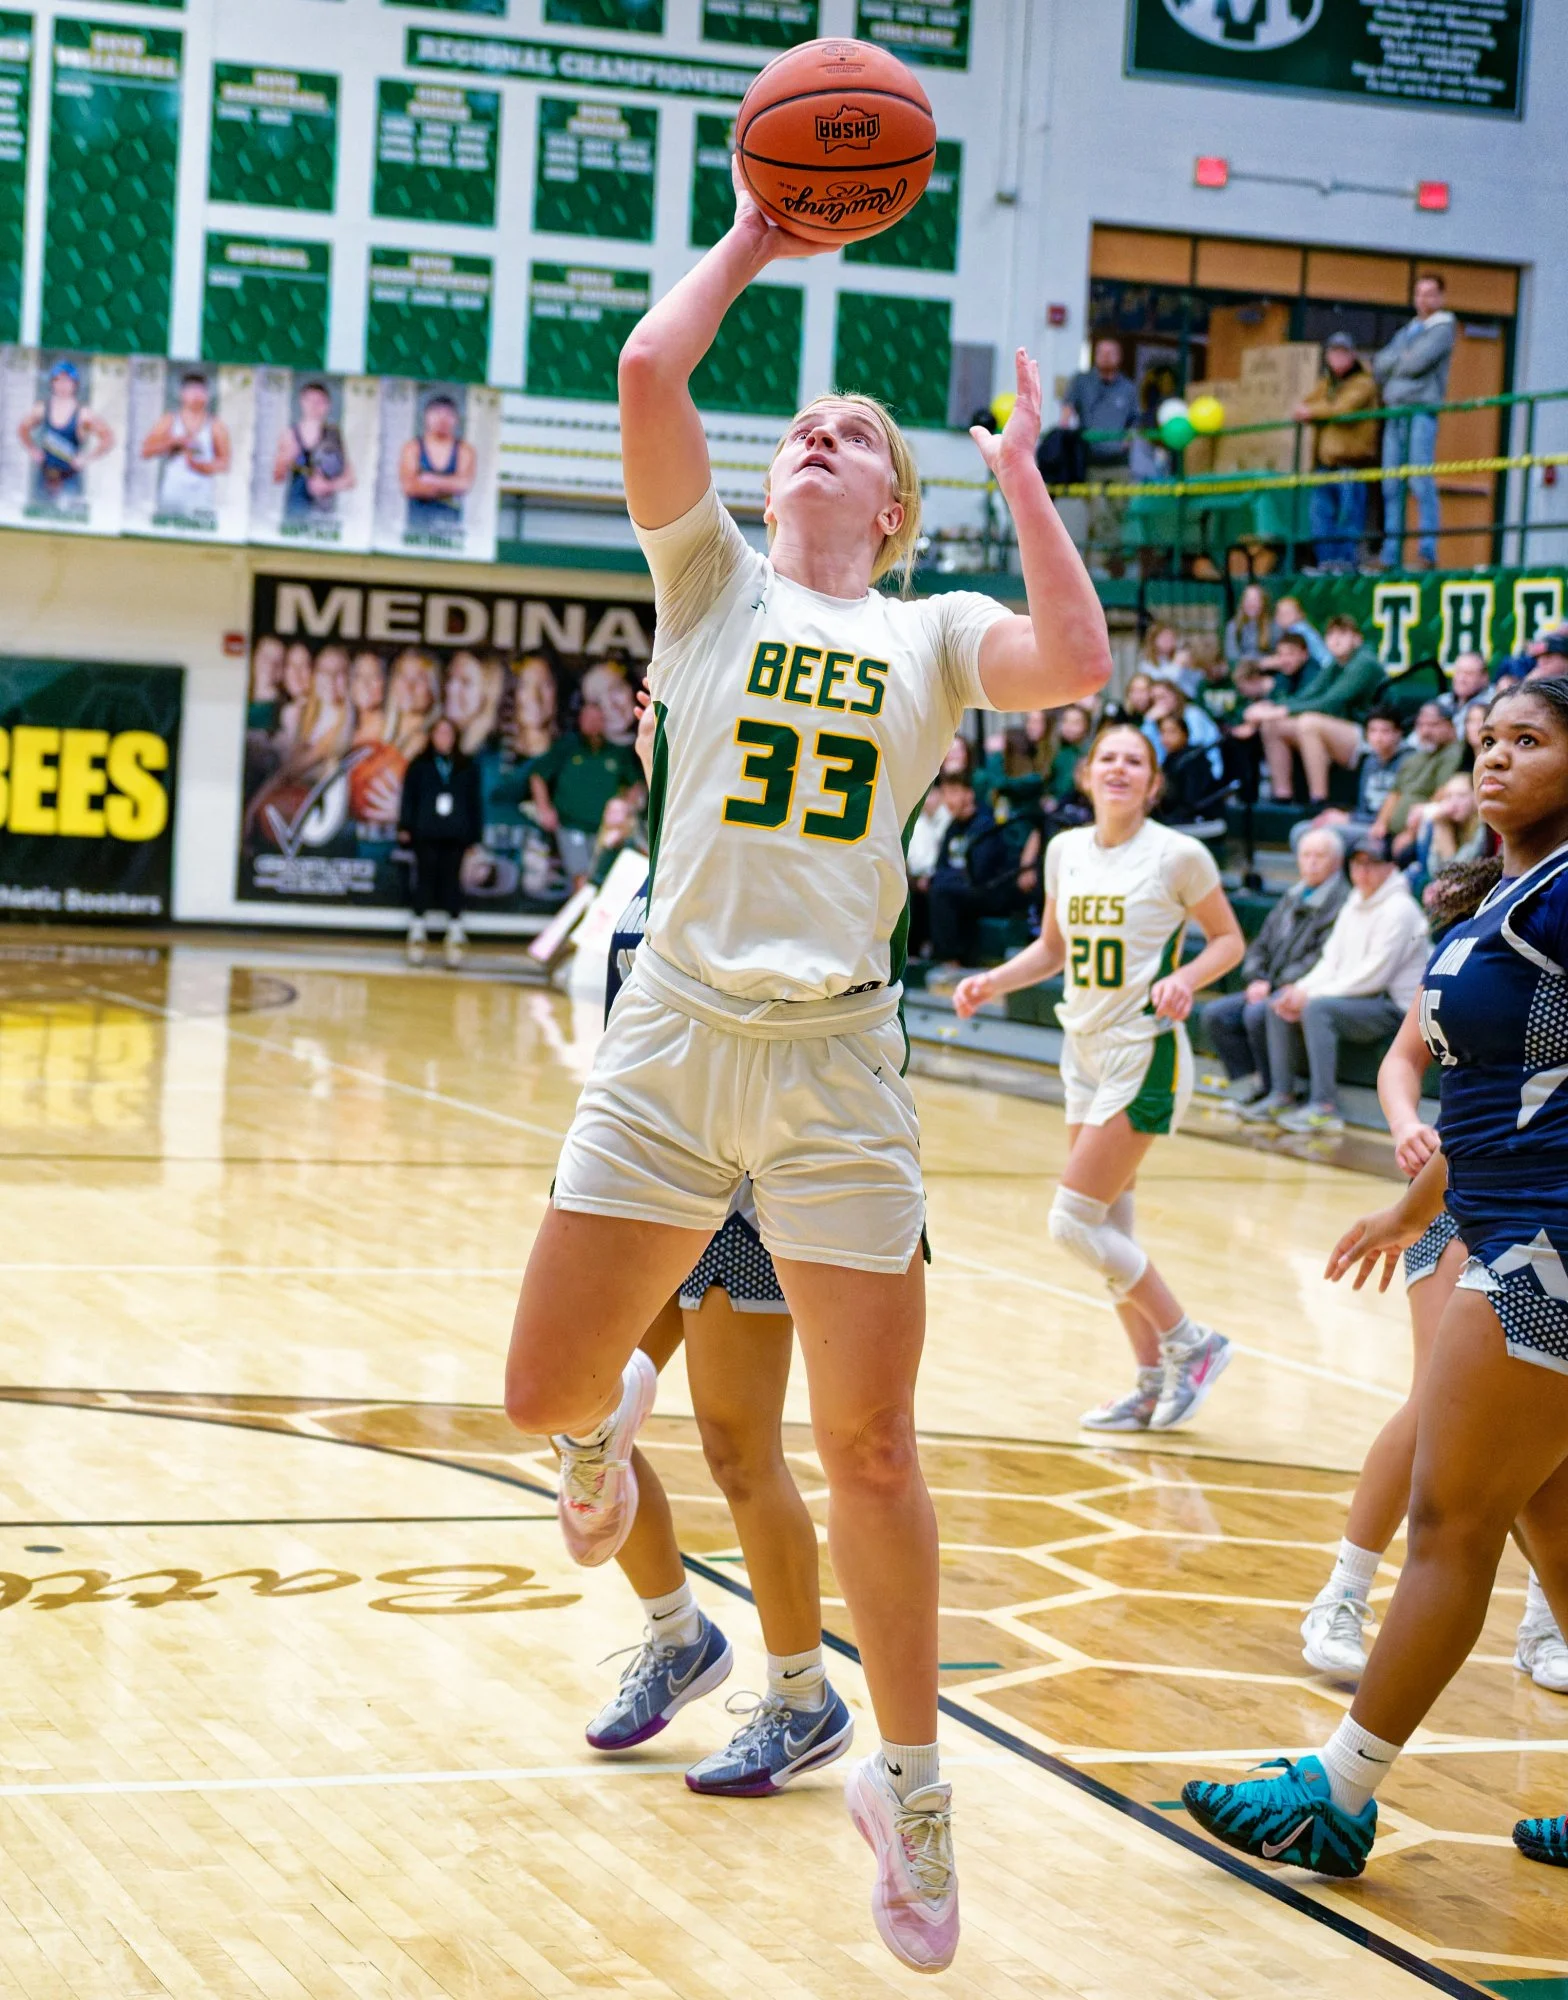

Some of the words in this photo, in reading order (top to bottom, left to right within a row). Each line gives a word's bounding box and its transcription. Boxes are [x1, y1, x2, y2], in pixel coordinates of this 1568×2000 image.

[819, 120, 877, 139] OHSAA
[781, 178, 907, 224] Rawlings
[274, 581, 651, 659] MEDINA
[745, 641, 890, 718] BEES
[0, 725, 169, 842] EES
[721, 717, 881, 845] 33
[1068, 896, 1125, 925] BEES
[1070, 936, 1125, 989] 20
